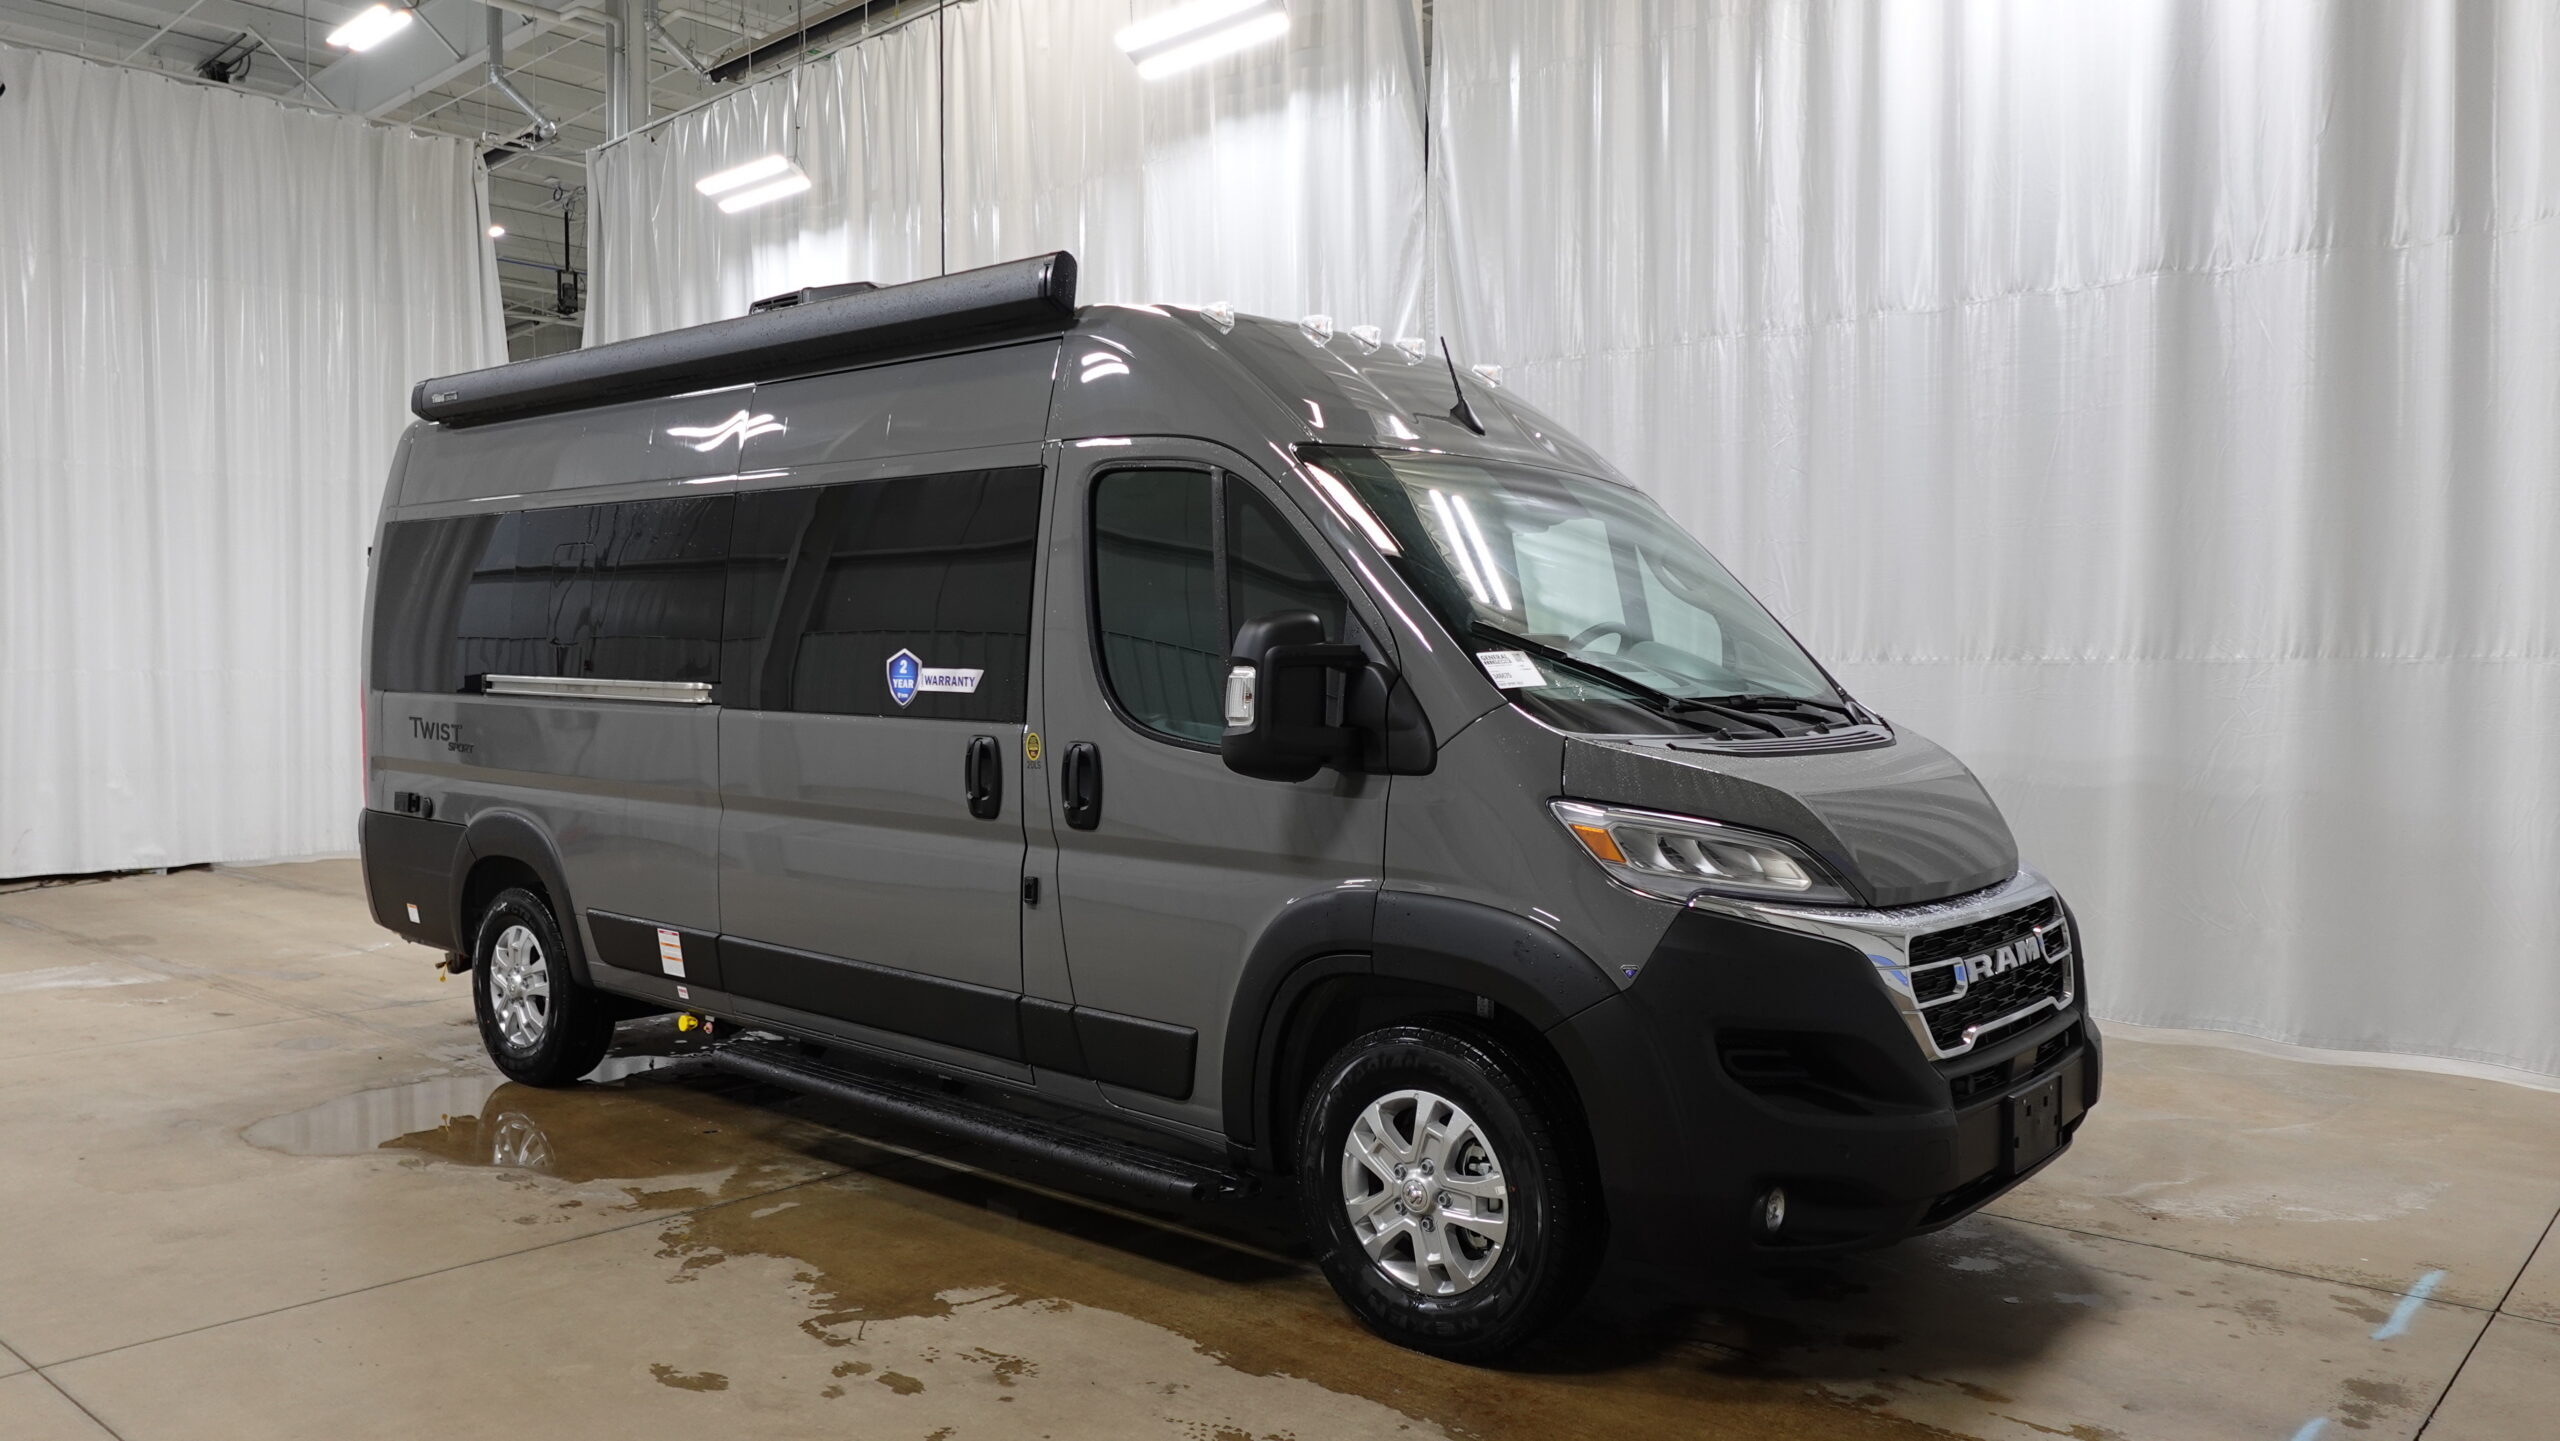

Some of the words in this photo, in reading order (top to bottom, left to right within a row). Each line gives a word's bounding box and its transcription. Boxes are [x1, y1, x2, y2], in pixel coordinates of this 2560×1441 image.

[899, 659, 908, 674] 2
[892, 678, 914, 689] YEAR
[924, 674, 976, 688] WARRANTY
[408, 716, 463, 743] TWIST
[447, 742, 475, 753] SPORT
[1964, 936, 2041, 984] RAM
